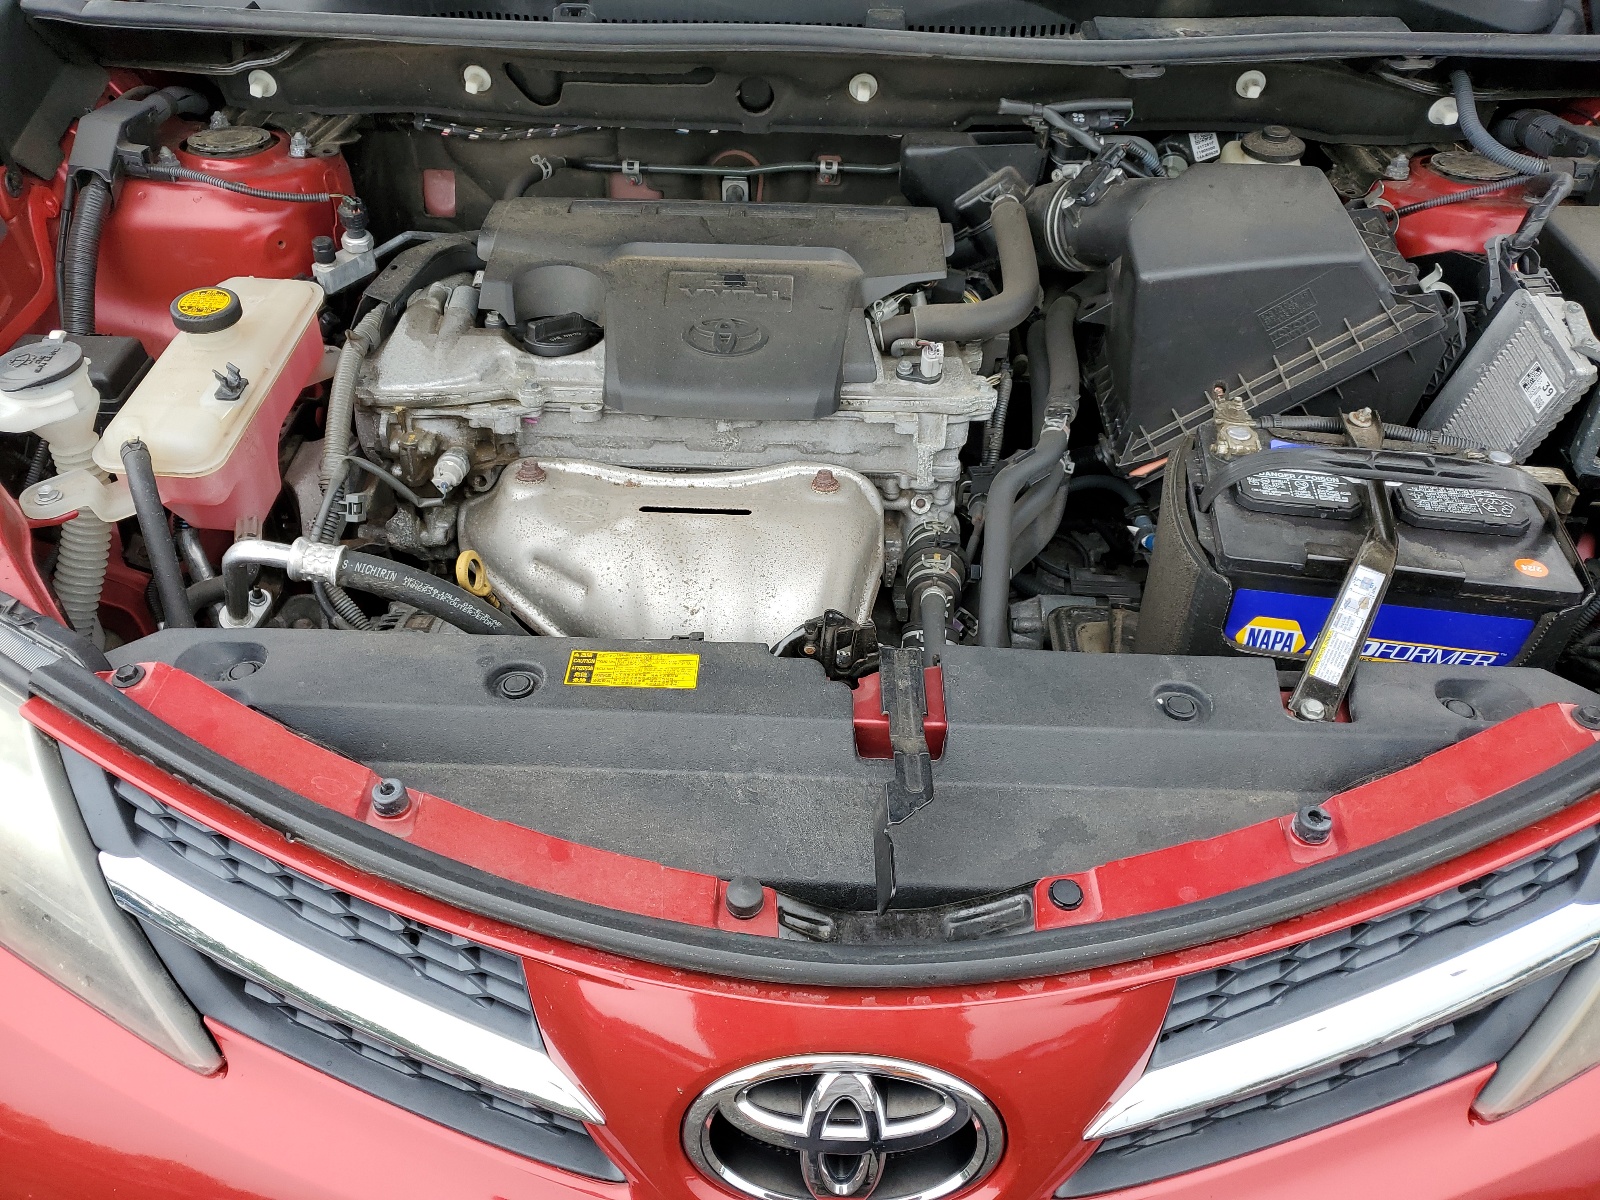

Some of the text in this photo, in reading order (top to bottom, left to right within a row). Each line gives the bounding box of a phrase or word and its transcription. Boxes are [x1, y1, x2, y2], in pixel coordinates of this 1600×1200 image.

[1542, 381, 1554, 397] 39
[354, 561, 398, 582] NICHIRIN
[1246, 627, 1295, 653] NAPA
